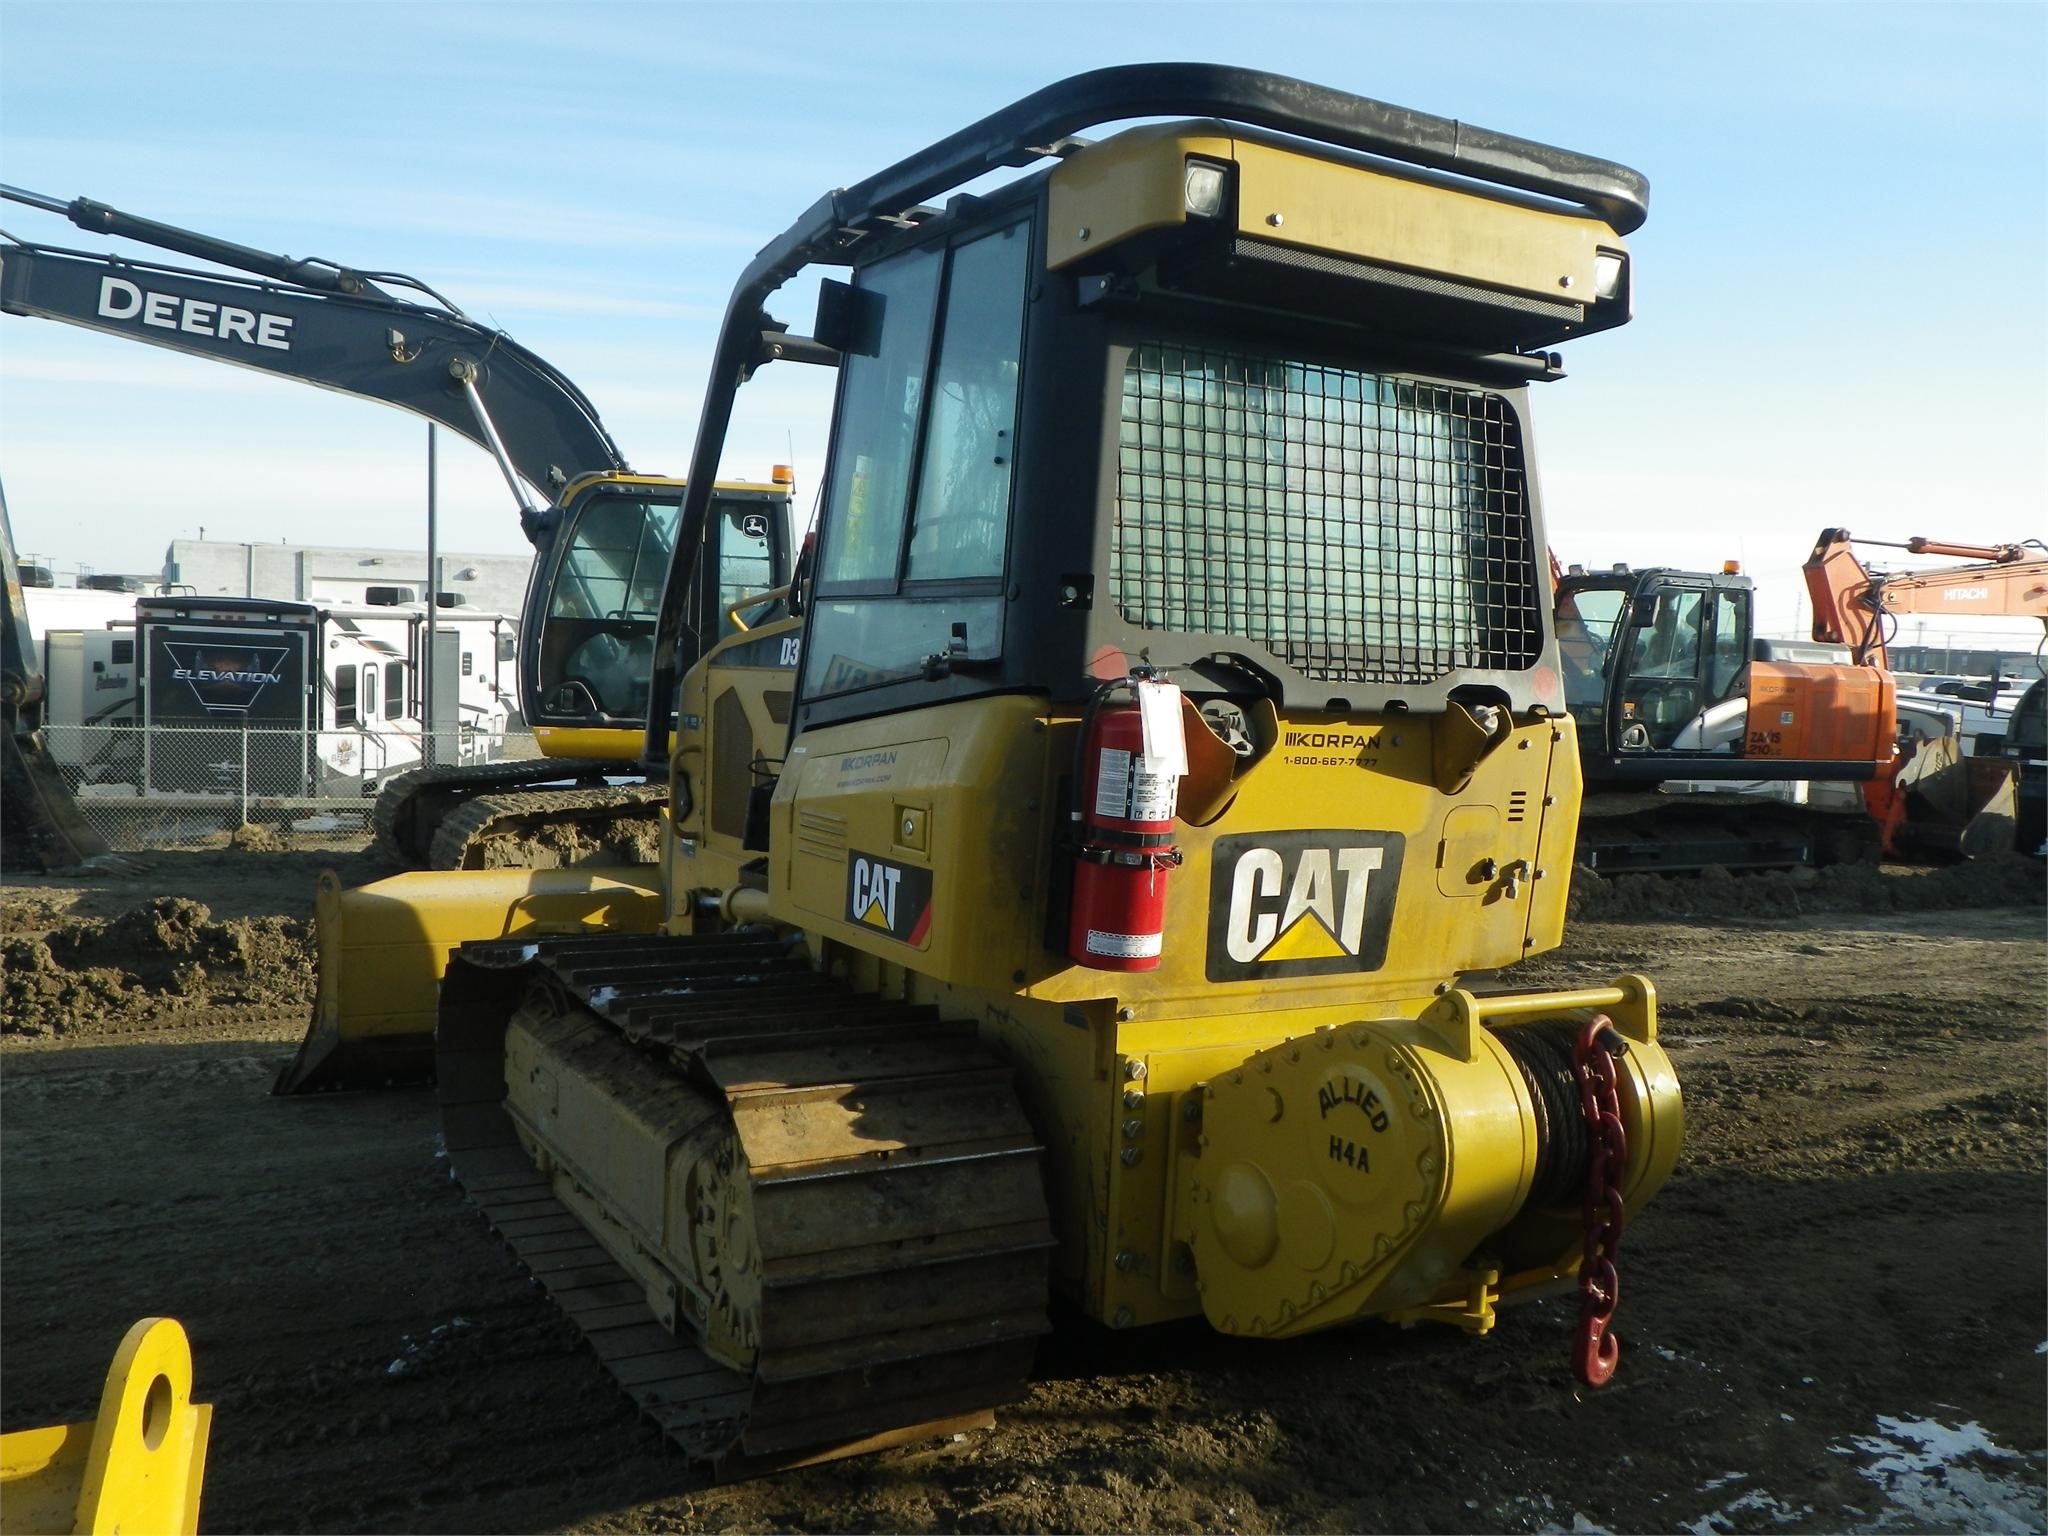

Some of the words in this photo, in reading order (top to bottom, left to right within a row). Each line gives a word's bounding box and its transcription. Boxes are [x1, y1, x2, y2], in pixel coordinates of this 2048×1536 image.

[98, 275, 293, 351] DEERE
[1944, 587, 1988, 601] HITACHI
[780, 637, 799, 666] D3
[172, 668, 281, 684] ELEVATION
[1285, 732, 1380, 749] KORPAN
[841, 751, 898, 771] KORPAN
[1284, 756, 1377, 767] 1-800-667-7777
[852, 857, 901, 932] CAT
[1226, 847, 1384, 963] CAT
[1318, 1076, 1390, 1133] ALLIED
[1329, 1135, 1369, 1174] H4A
